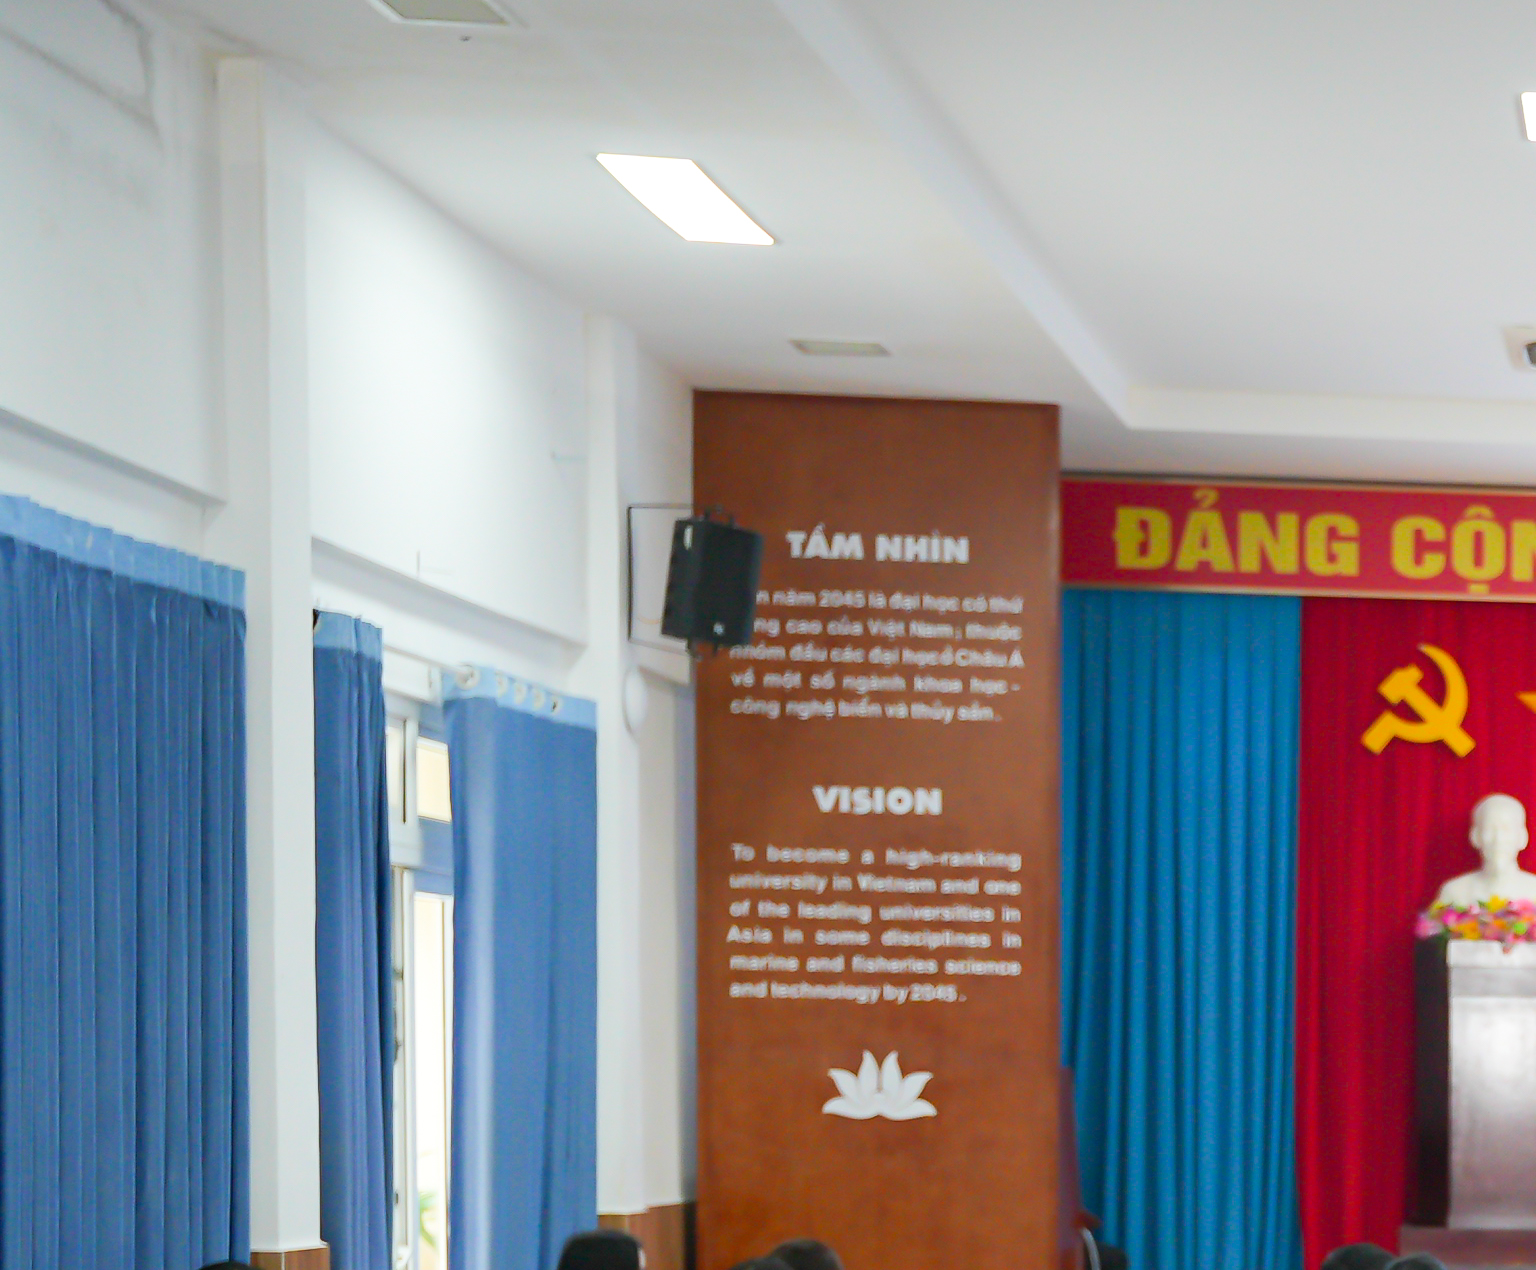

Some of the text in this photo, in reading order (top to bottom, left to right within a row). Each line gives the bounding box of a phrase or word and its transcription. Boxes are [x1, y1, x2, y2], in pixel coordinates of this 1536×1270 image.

[786, 523, 970, 564] TẦM NHÌN
[1112, 488, 1361, 577] ĐẢNG
[812, 785, 943, 816] VISION
[731, 842, 1022, 872] To become a high-ranking
[728, 872, 1022, 896] university in Vietnam and one
[728, 898, 1022, 924] of the leading universities in
[726, 925, 1022, 950] Asia in some disciplines in
[729, 953, 1022, 976] marine and fisheries science
[729, 981, 768, 999] and
[770, 981, 881, 1004] technology
[882, 983, 910, 1005] by
